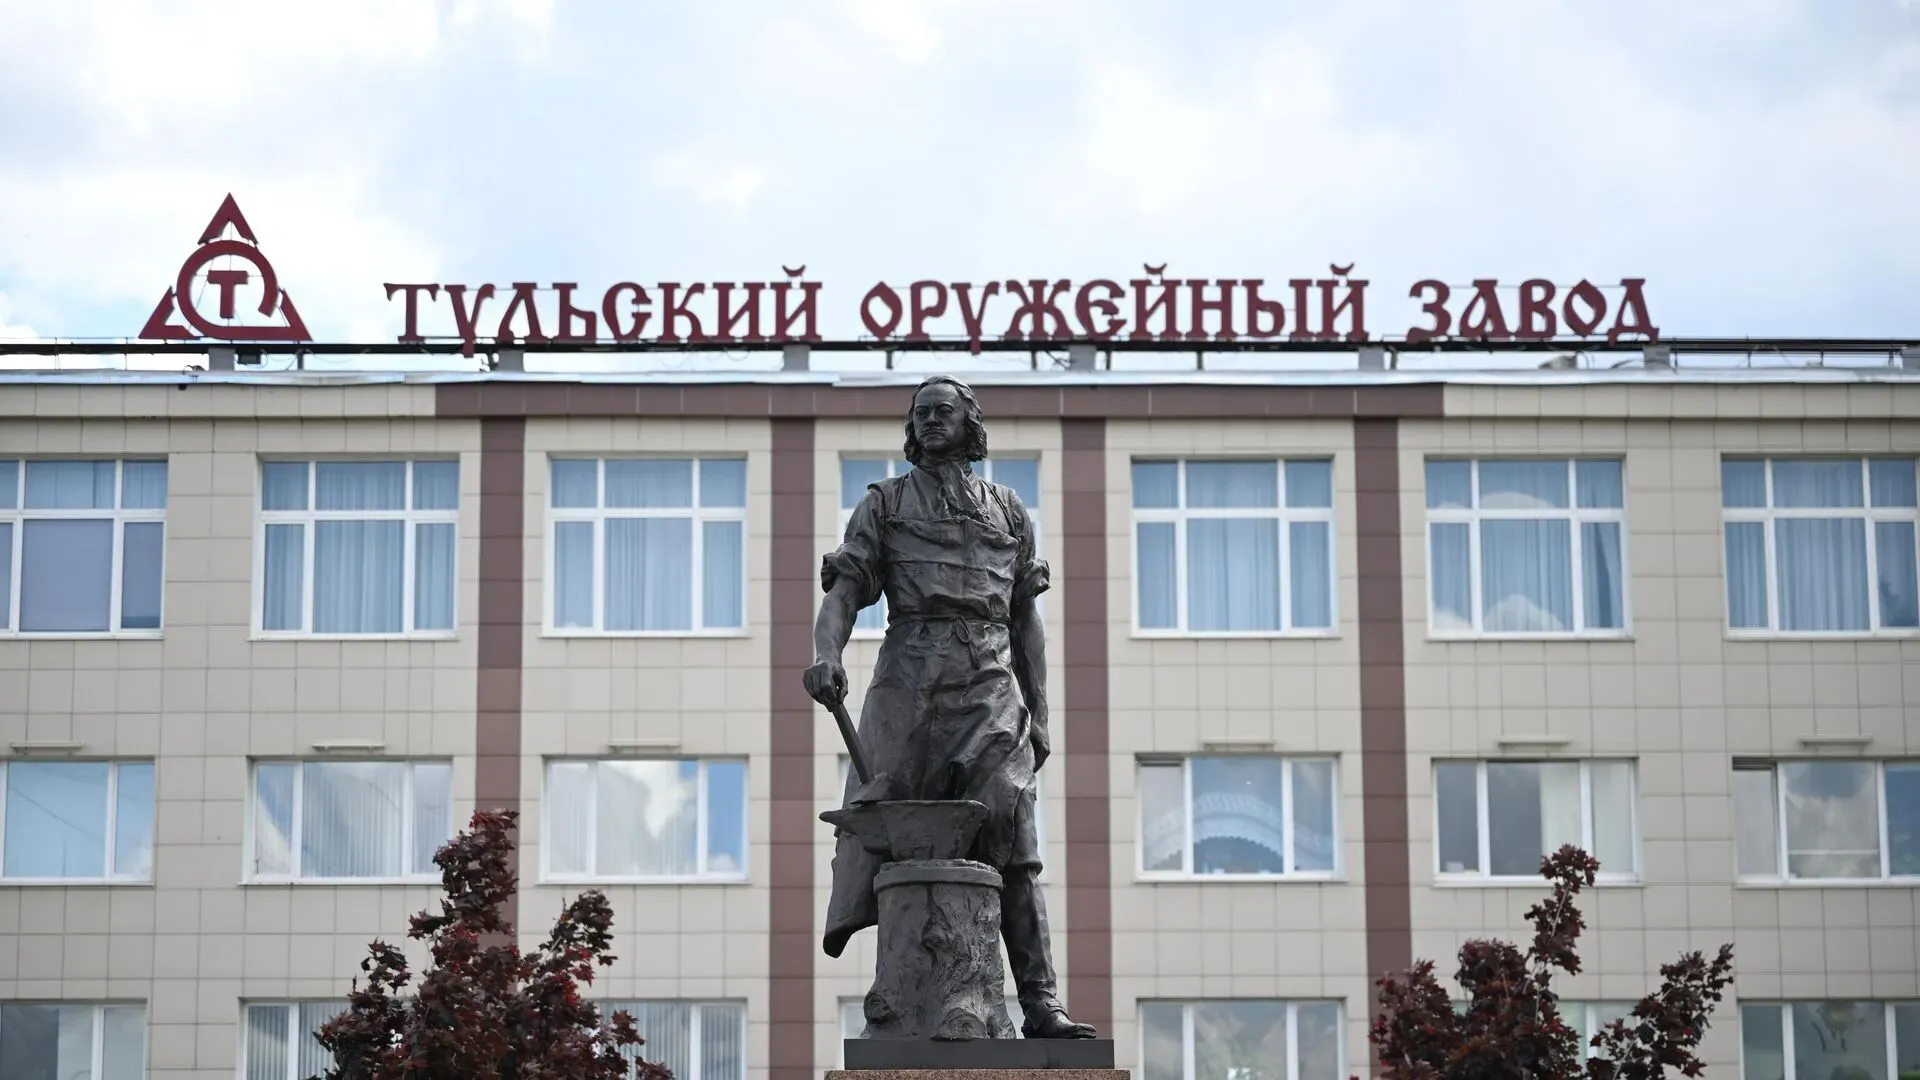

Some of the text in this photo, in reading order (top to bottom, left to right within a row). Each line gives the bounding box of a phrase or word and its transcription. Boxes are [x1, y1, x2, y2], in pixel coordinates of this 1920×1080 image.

[384, 263, 1660, 358] ТУЛЬСКИЙ ОРУЖЕЙНЫЙ ЗАВОД
